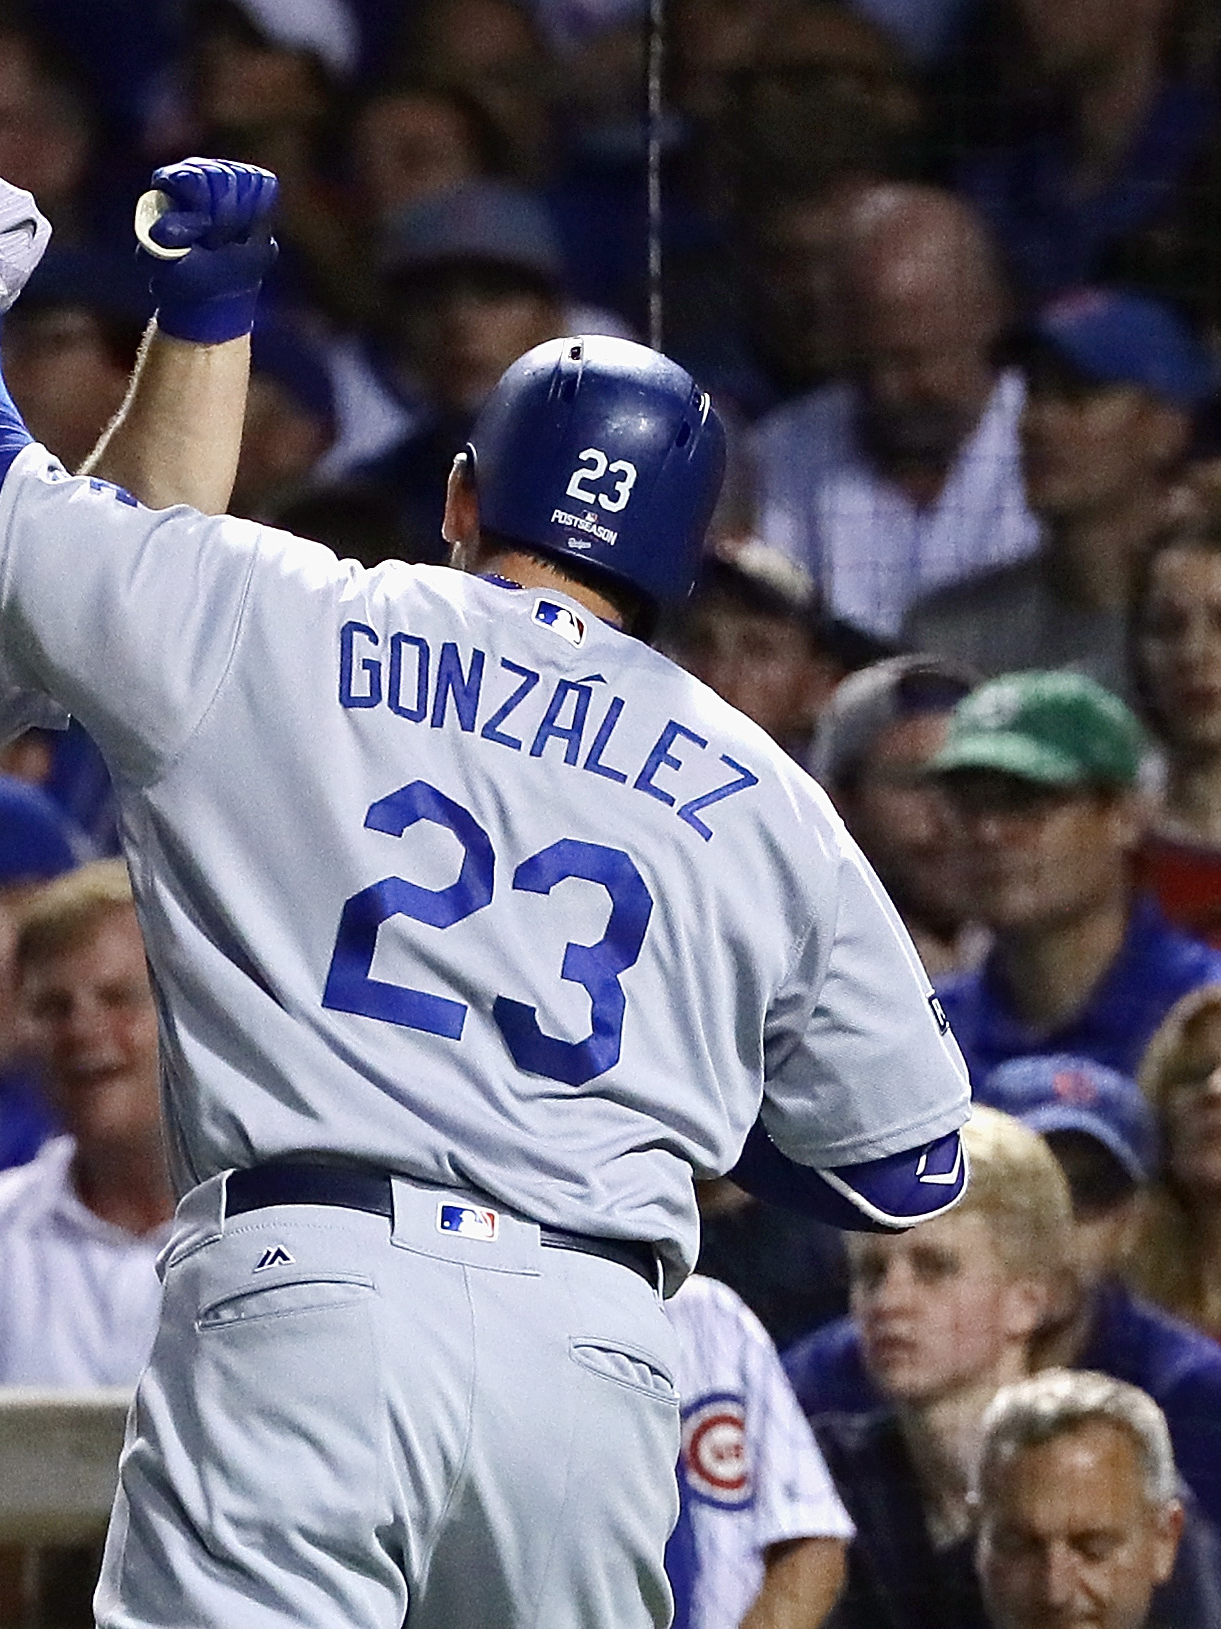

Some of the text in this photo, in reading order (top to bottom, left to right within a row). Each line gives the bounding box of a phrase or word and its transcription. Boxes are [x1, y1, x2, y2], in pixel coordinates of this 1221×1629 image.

[550, 509, 618, 546] POSTSEASON
[566, 447, 638, 513] 23
[339, 621, 759, 843] GONZÁLEZ
[321, 779, 654, 1088] 23
